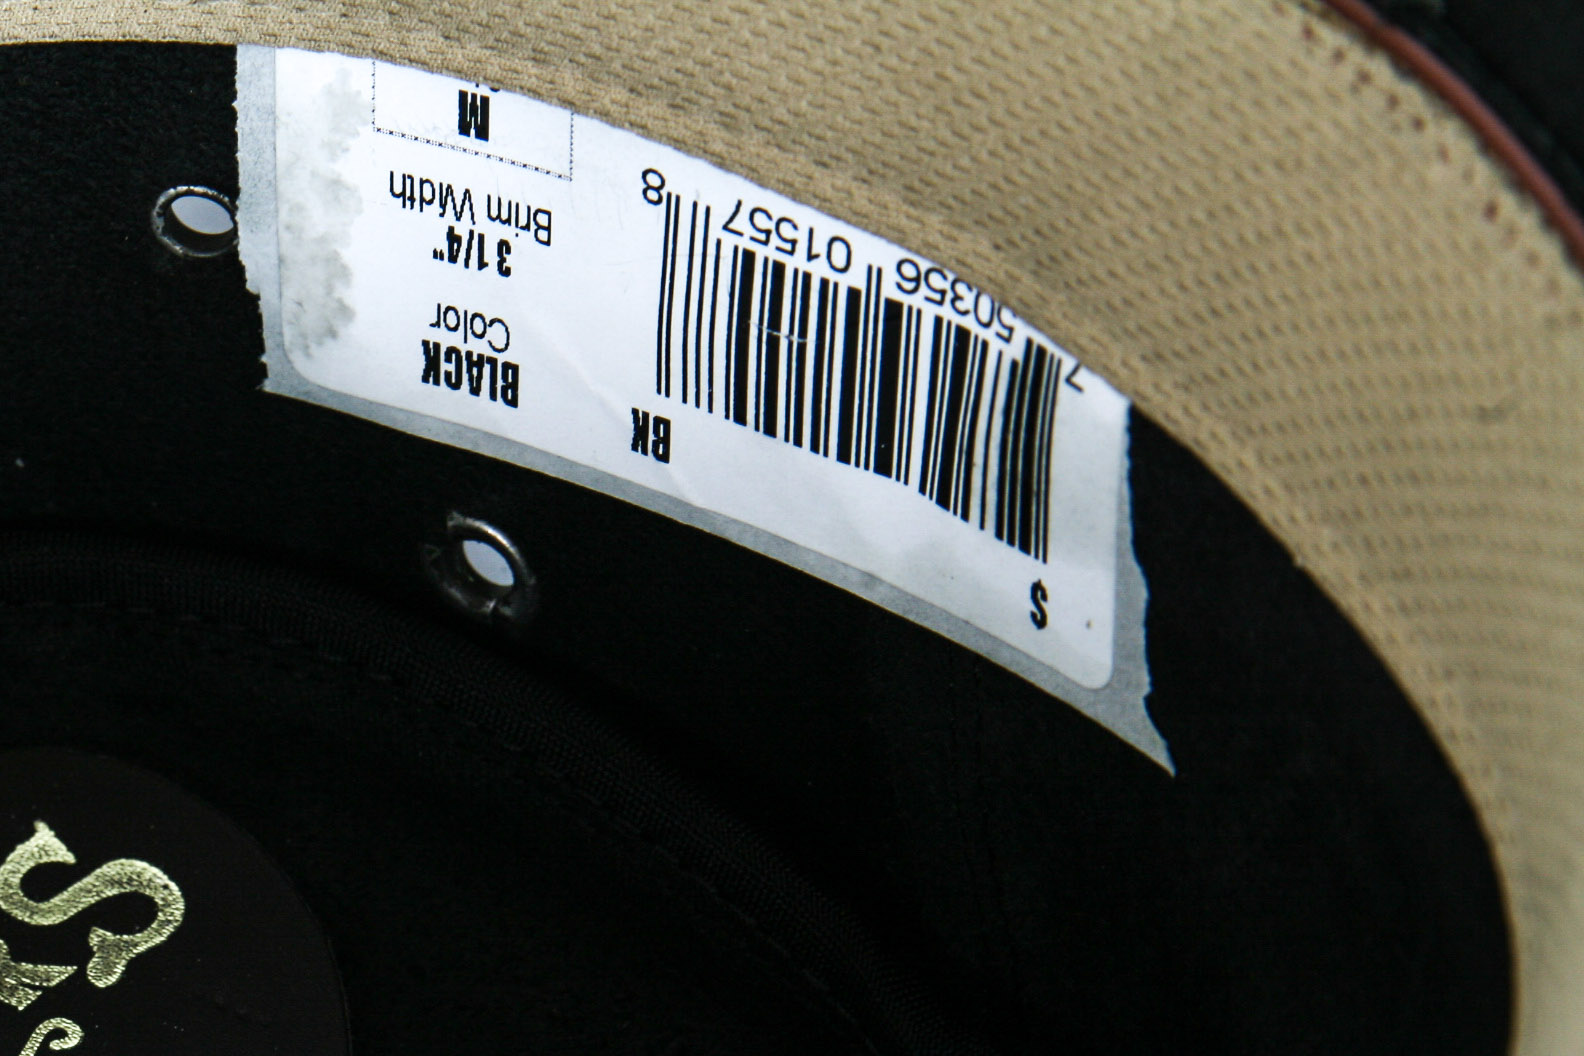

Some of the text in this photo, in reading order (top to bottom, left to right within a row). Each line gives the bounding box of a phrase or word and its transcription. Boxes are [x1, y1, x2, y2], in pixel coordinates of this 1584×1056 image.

[458, 89, 490, 142] M
[389, 170, 552, 246] Brim Width
[641, 168, 666, 206] 8
[722, 199, 852, 274] 01557
[429, 303, 510, 353] Color
[896, 258, 1016, 344] 50356
[421, 338, 520, 408] BLACK
[631, 407, 671, 464] BK
